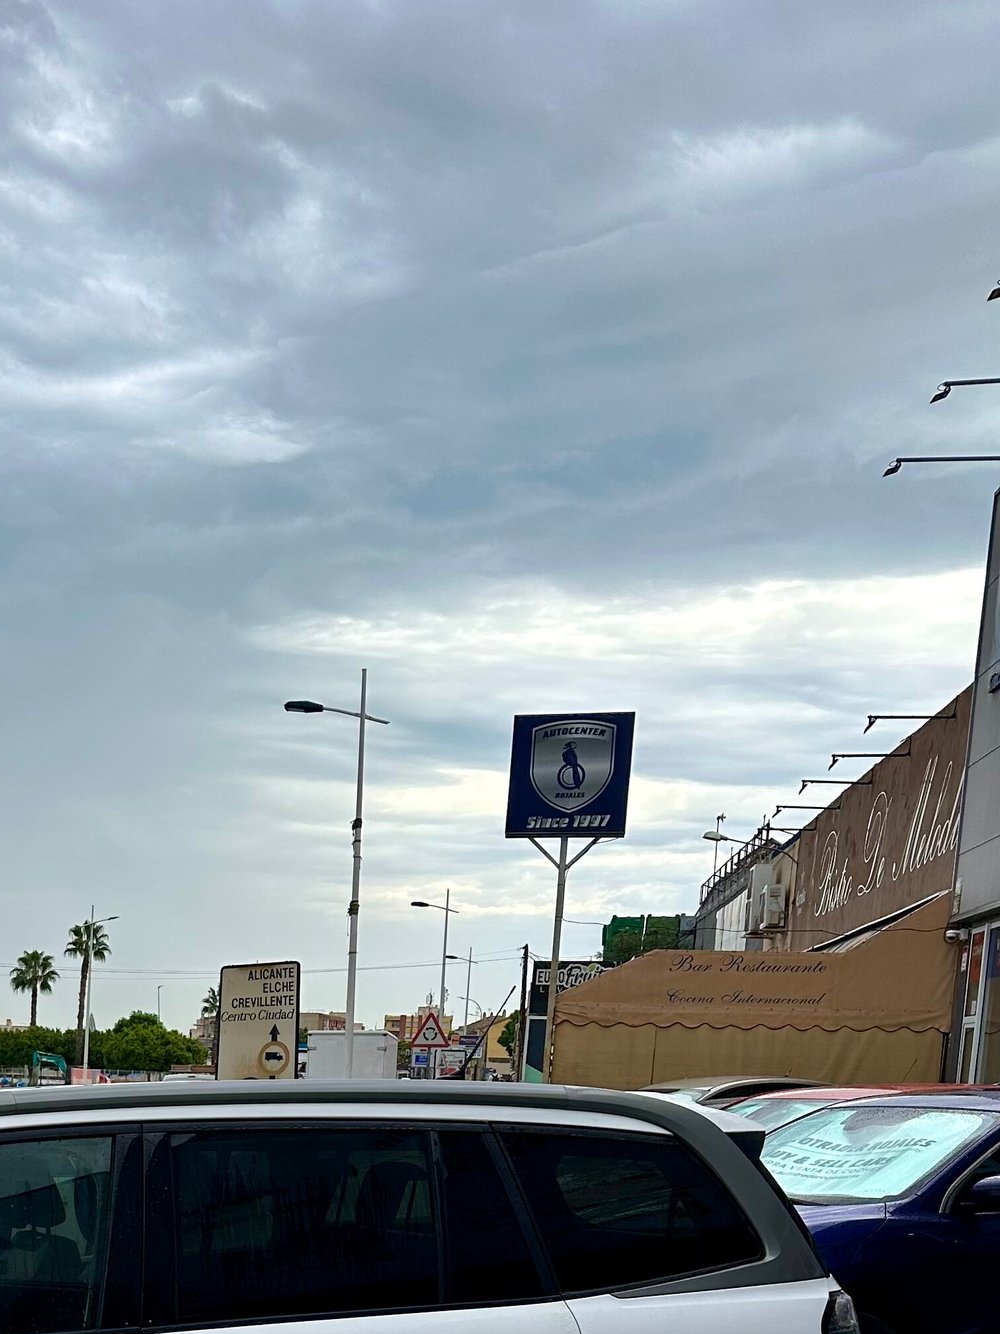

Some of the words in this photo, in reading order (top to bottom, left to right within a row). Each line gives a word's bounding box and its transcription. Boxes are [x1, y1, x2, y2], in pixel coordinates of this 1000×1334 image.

[542, 727, 607, 739] AUTOCENTER
[526, 816, 569, 829] Since
[573, 814, 611, 828] 1997
[669, 954, 712, 973] Bar
[720, 954, 827, 973] Restaurante
[248, 967, 295, 981] ALICANTE
[263, 981, 294, 993] ELCHE
[231, 995, 295, 1009] CREVILLENTE
[666, 988, 714, 1004] Cocina
[721, 989, 826, 1005] Internacional
[221, 1011, 257, 1022] Centro
[258, 1009, 295, 1021] Ciudad
[809, 1158, 850, 1168] SELL
